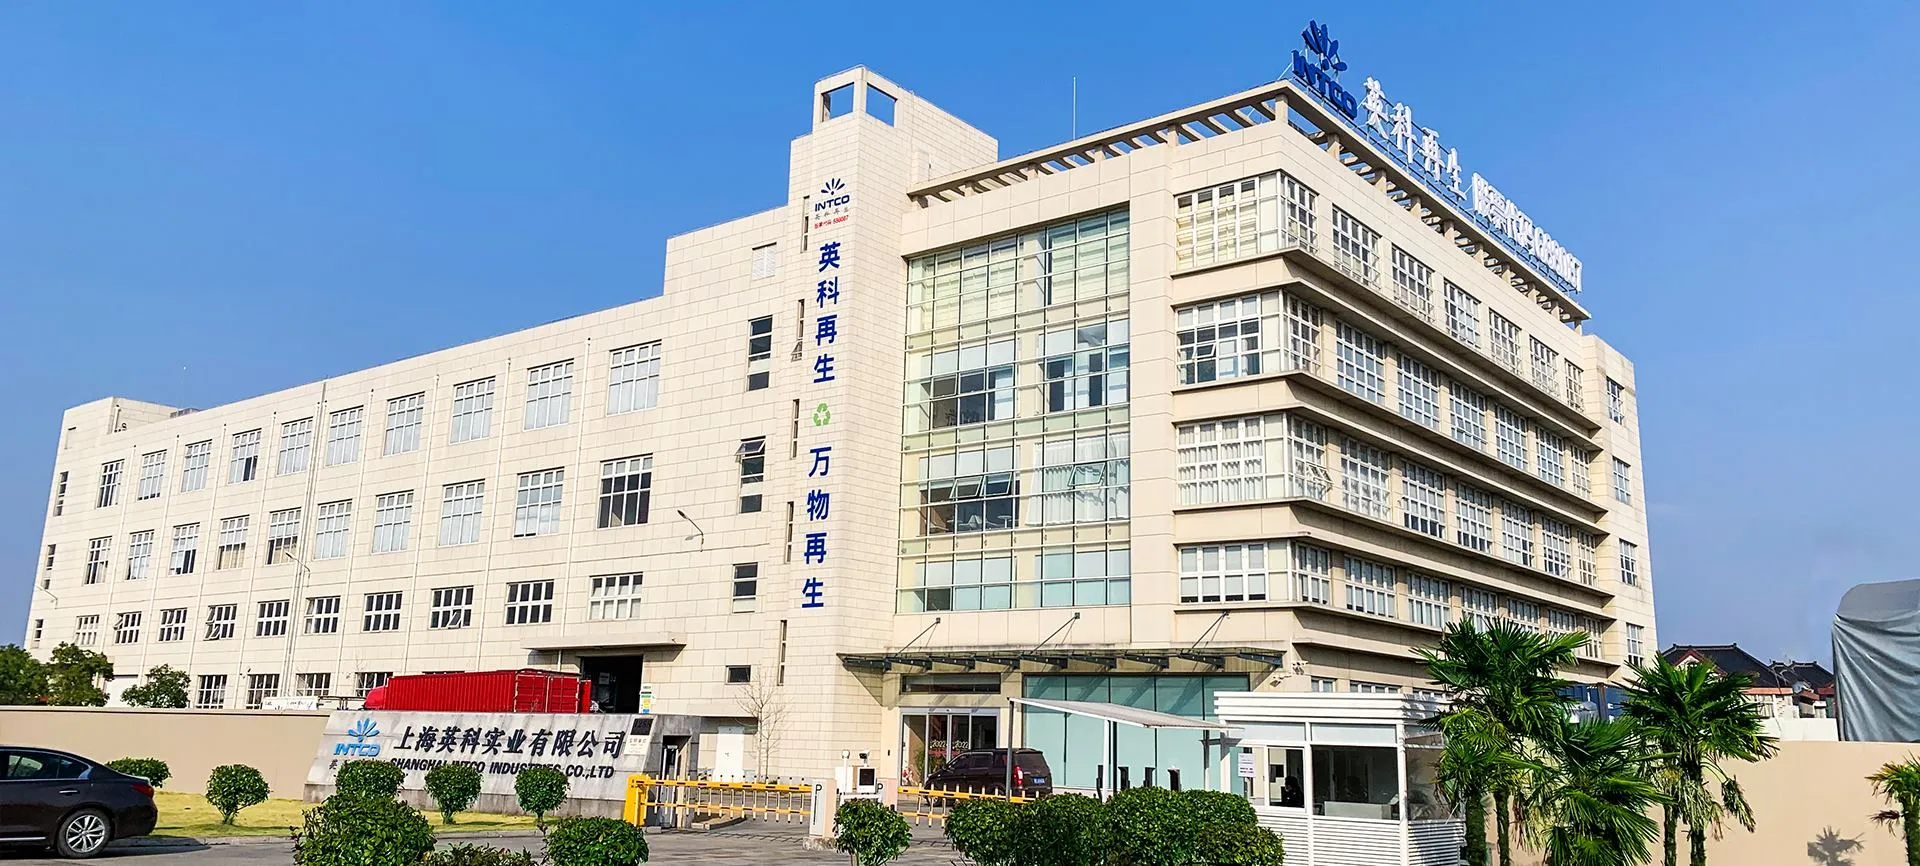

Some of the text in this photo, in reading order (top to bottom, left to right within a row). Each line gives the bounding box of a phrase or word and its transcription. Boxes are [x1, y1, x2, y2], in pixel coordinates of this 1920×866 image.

[1291, 50, 1358, 120] INTCO
[1362, 76, 1467, 201] 英科再生
[814, 194, 850, 212] INTCO
[813, 241, 841, 384] 英科再生
[801, 446, 832, 609] 万物再生
[333, 743, 381, 757] INTCO
[393, 725, 626, 759] 上海英科实业有限公司
[565, 764, 615, 780] CO.,LTD
